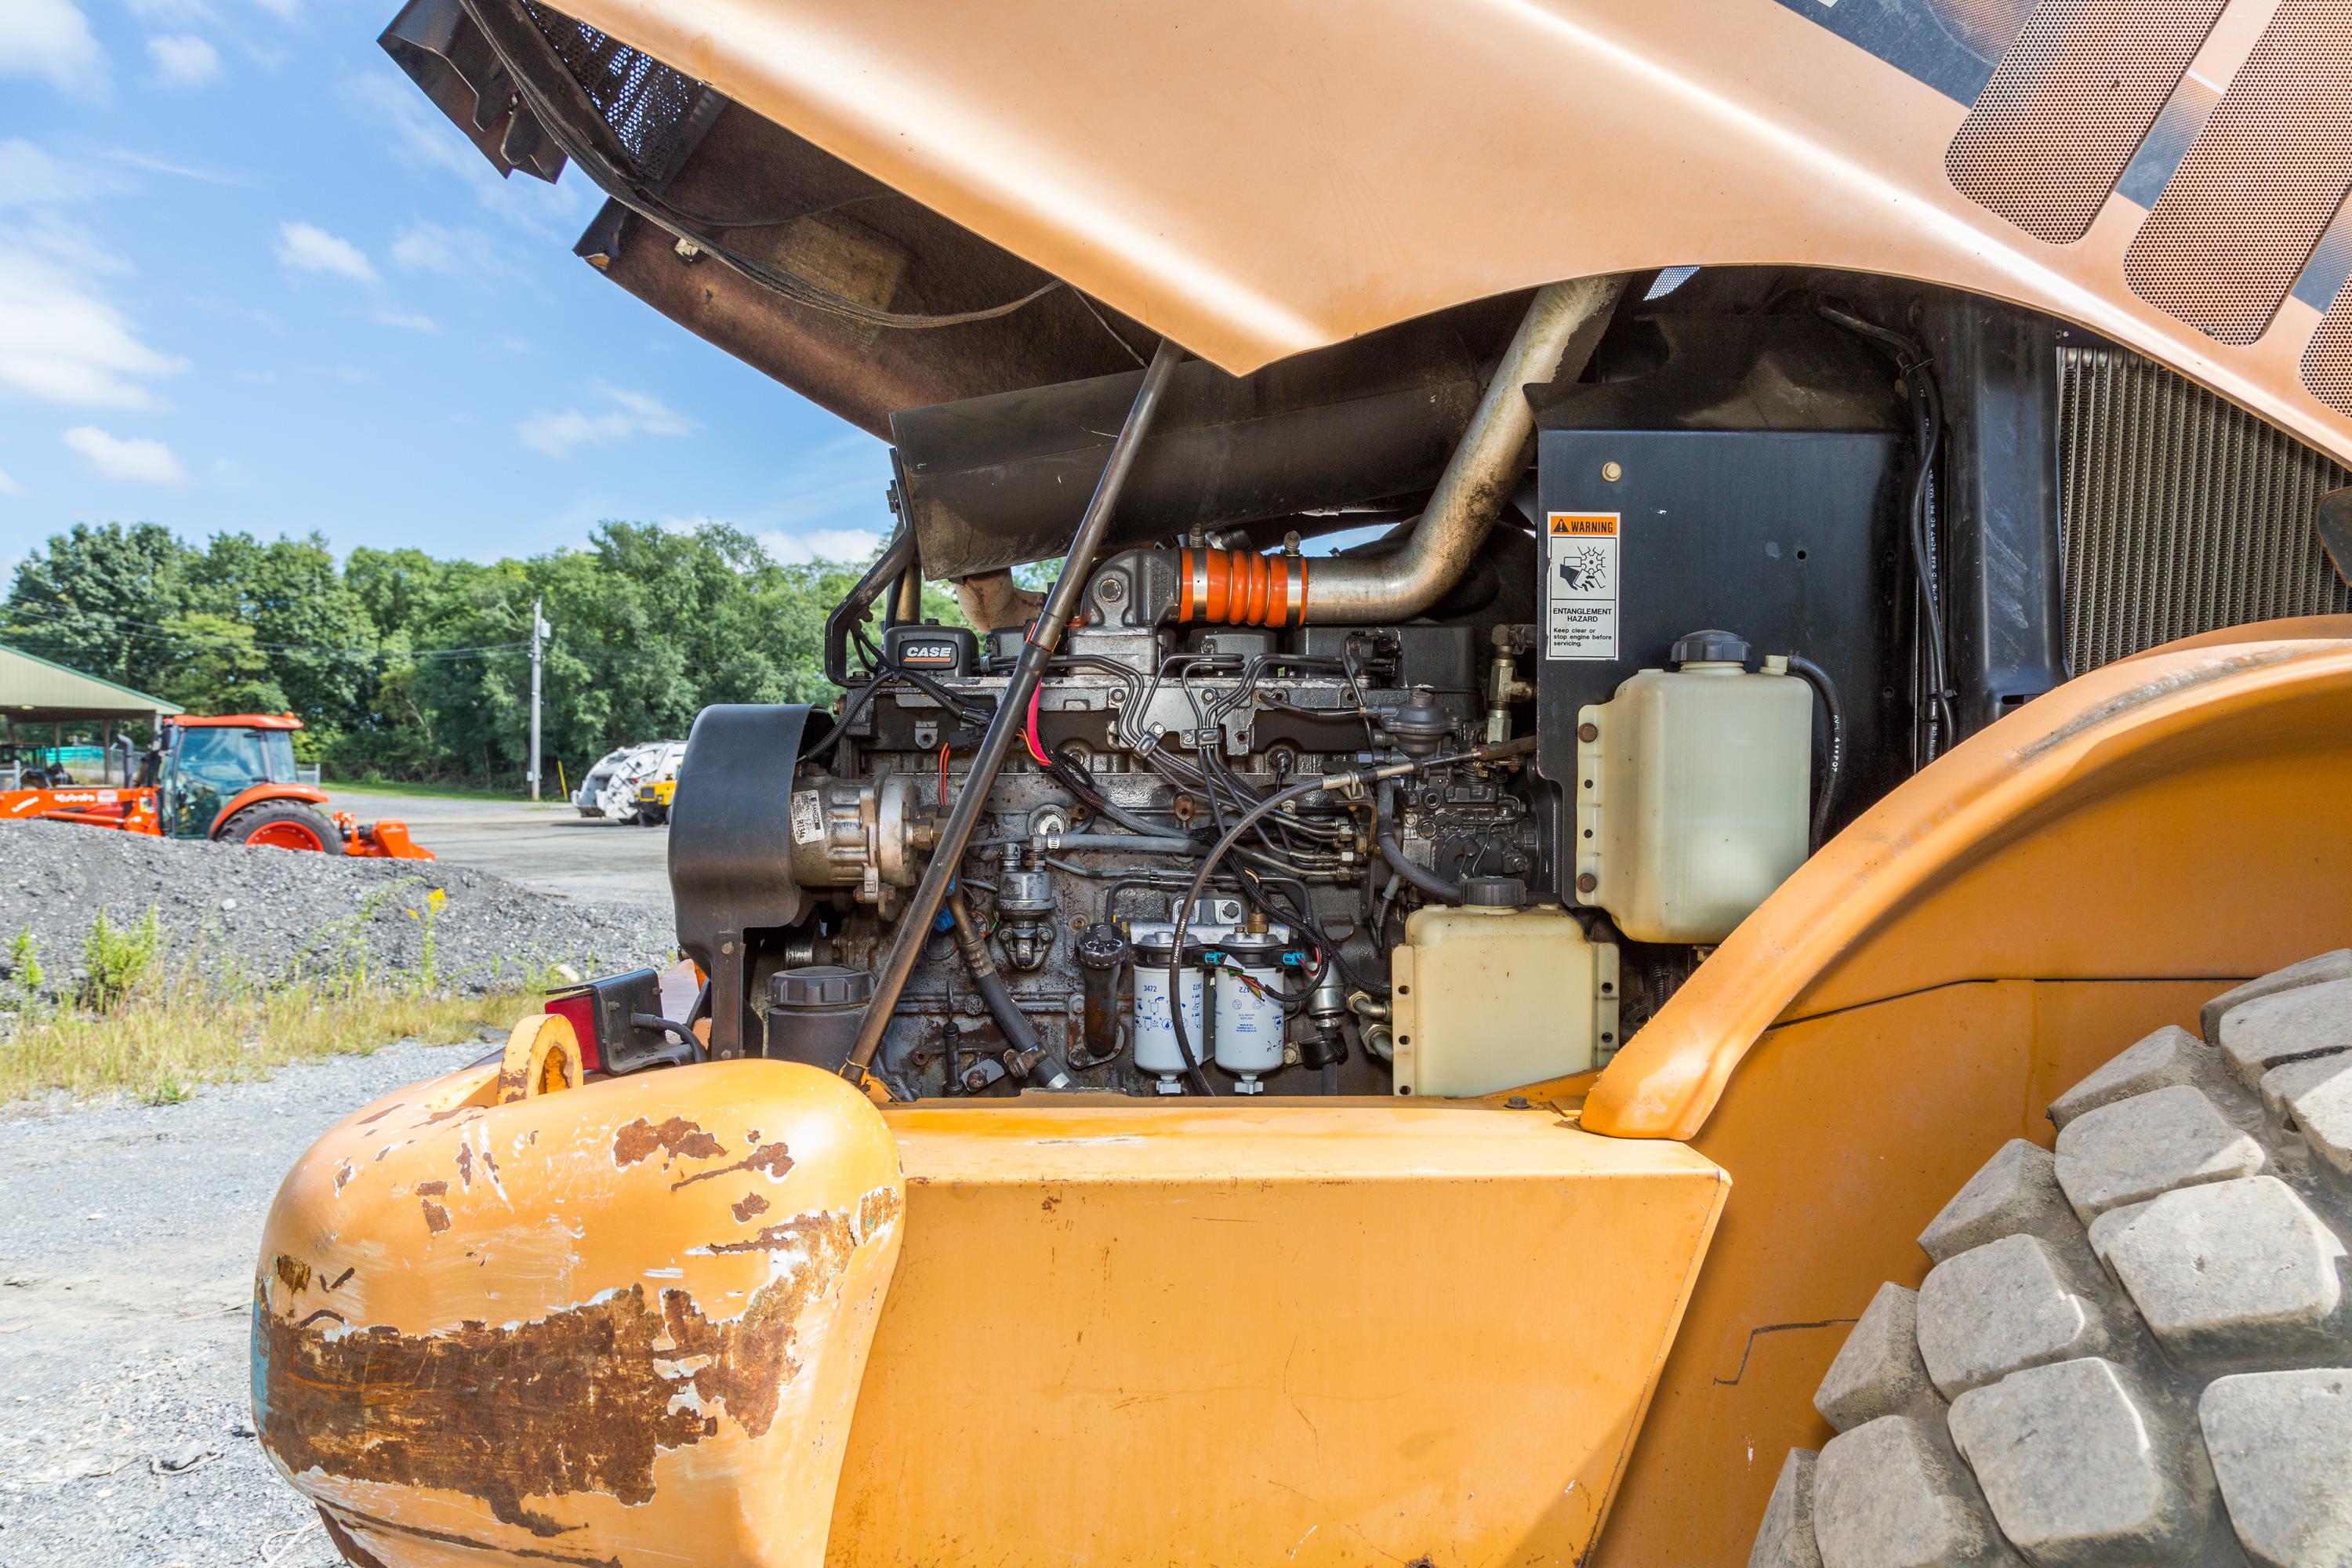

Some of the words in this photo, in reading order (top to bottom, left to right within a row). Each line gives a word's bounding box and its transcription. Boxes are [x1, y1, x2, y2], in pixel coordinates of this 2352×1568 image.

[1571, 521, 1613, 533] WARNING
[906, 647, 952, 657] CASE
[54, 793, 95, 802] Kubota
